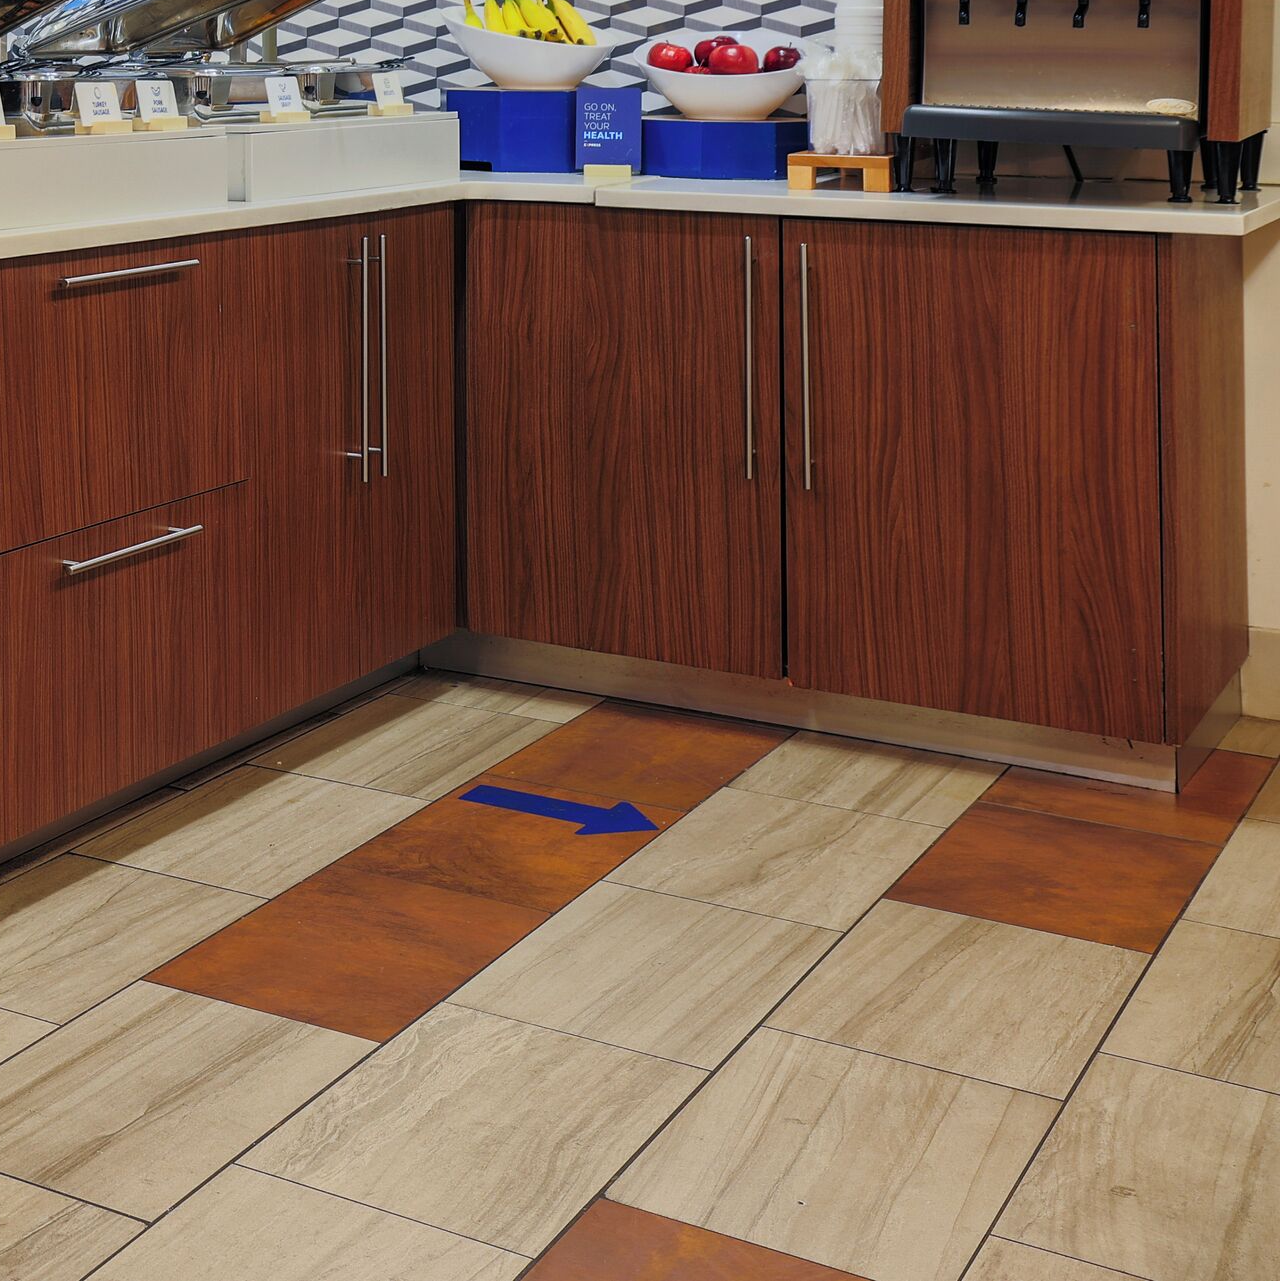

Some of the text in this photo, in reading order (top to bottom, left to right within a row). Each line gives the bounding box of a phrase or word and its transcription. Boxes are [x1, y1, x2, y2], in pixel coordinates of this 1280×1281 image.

[583, 102, 617, 112] GO ON,
[583, 112, 612, 120] TREAT
[583, 121, 610, 130] YOUR
[583, 131, 623, 140] HEALTH
